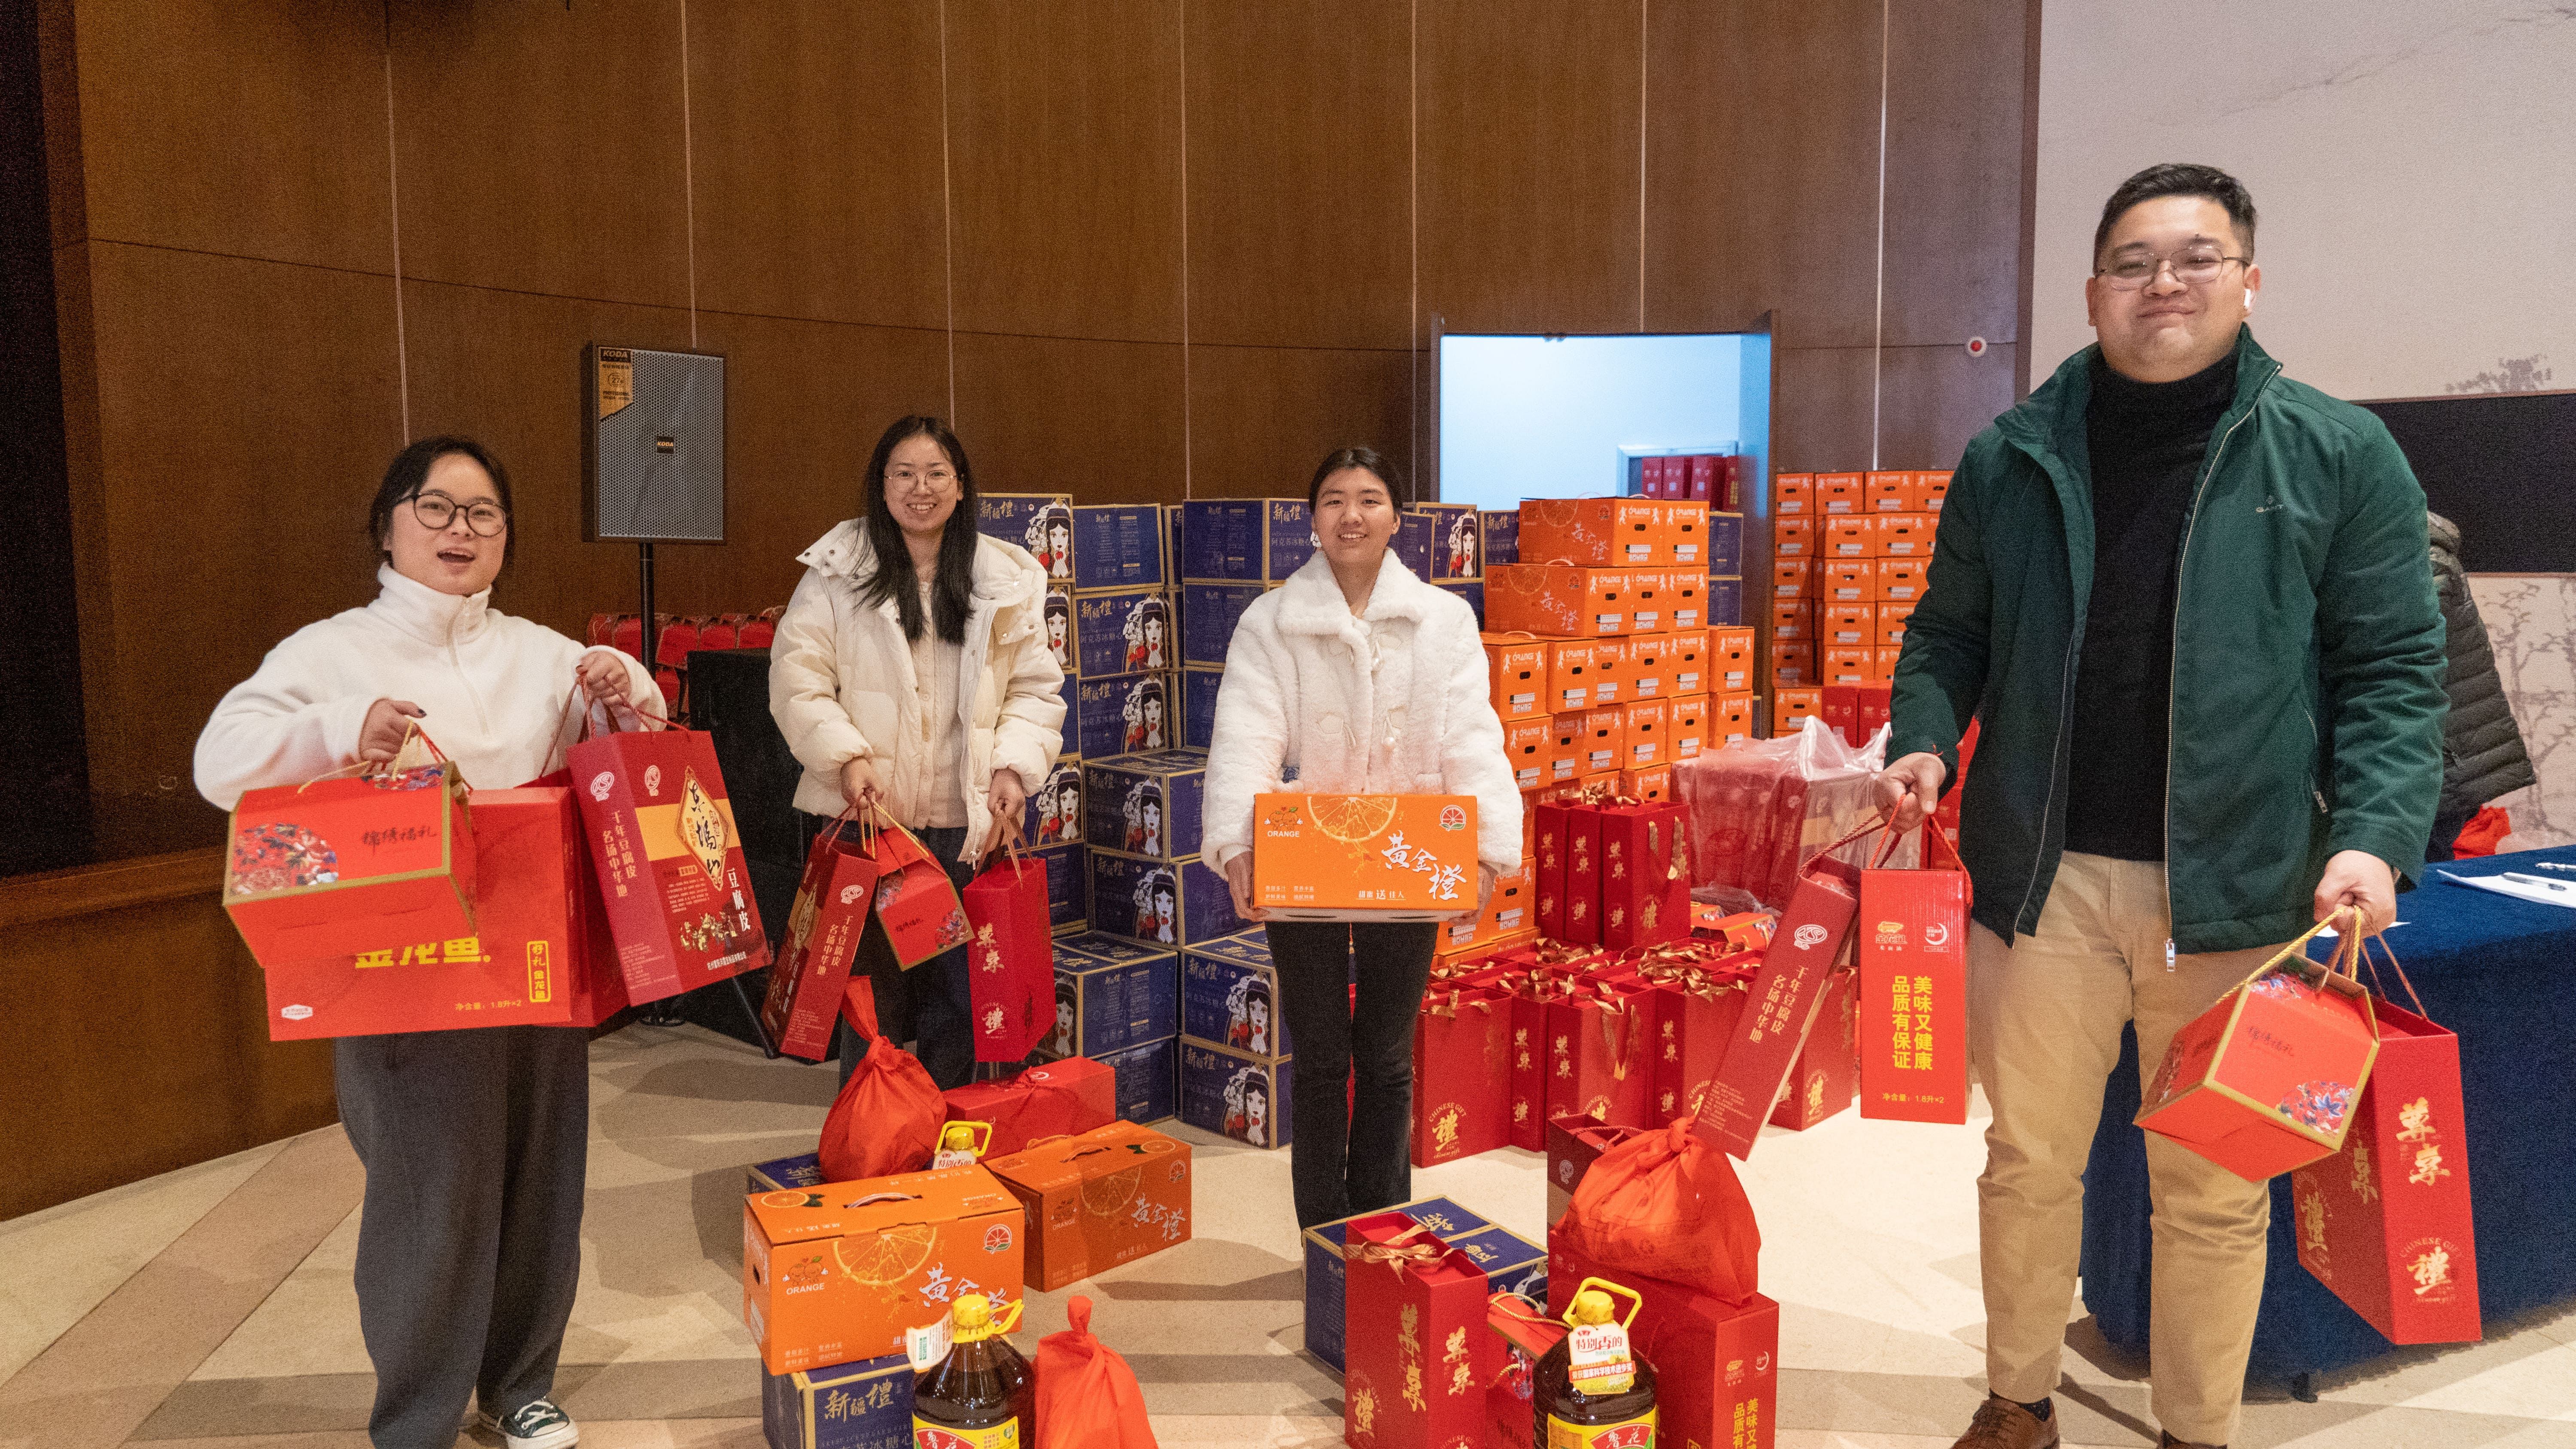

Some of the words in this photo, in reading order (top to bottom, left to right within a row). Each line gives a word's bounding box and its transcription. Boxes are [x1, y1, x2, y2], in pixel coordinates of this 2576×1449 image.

[1381, 830, 1466, 900] 黄金橙
[727, 867, 750, 932] 豆腐皮
[1770, 966, 1808, 1035] 千年豆腐皮
[1892, 975, 1911, 1070] 品质有保证
[1913, 975, 1933, 1070] 美味又健康
[1429, 1103, 1455, 1122] CHINESE
[1688, 1079, 1711, 1100] CHINES
[2396, 1096, 2451, 1186] 尊享
[1052, 1218, 1076, 1231] ORANGE
[1131, 1192, 1186, 1242] 黄金橙
[786, 1282, 825, 1295] ORANGE
[1442, 1325, 1476, 1396] 尊享
[1576, 1335, 1623, 1351] 特别香的
[1571, 1362, 1634, 1379] 荣获国家科学技术进步奖
[824, 1378, 894, 1423] 新疆禮
[1608, 1425, 1642, 1449] 鲁花
